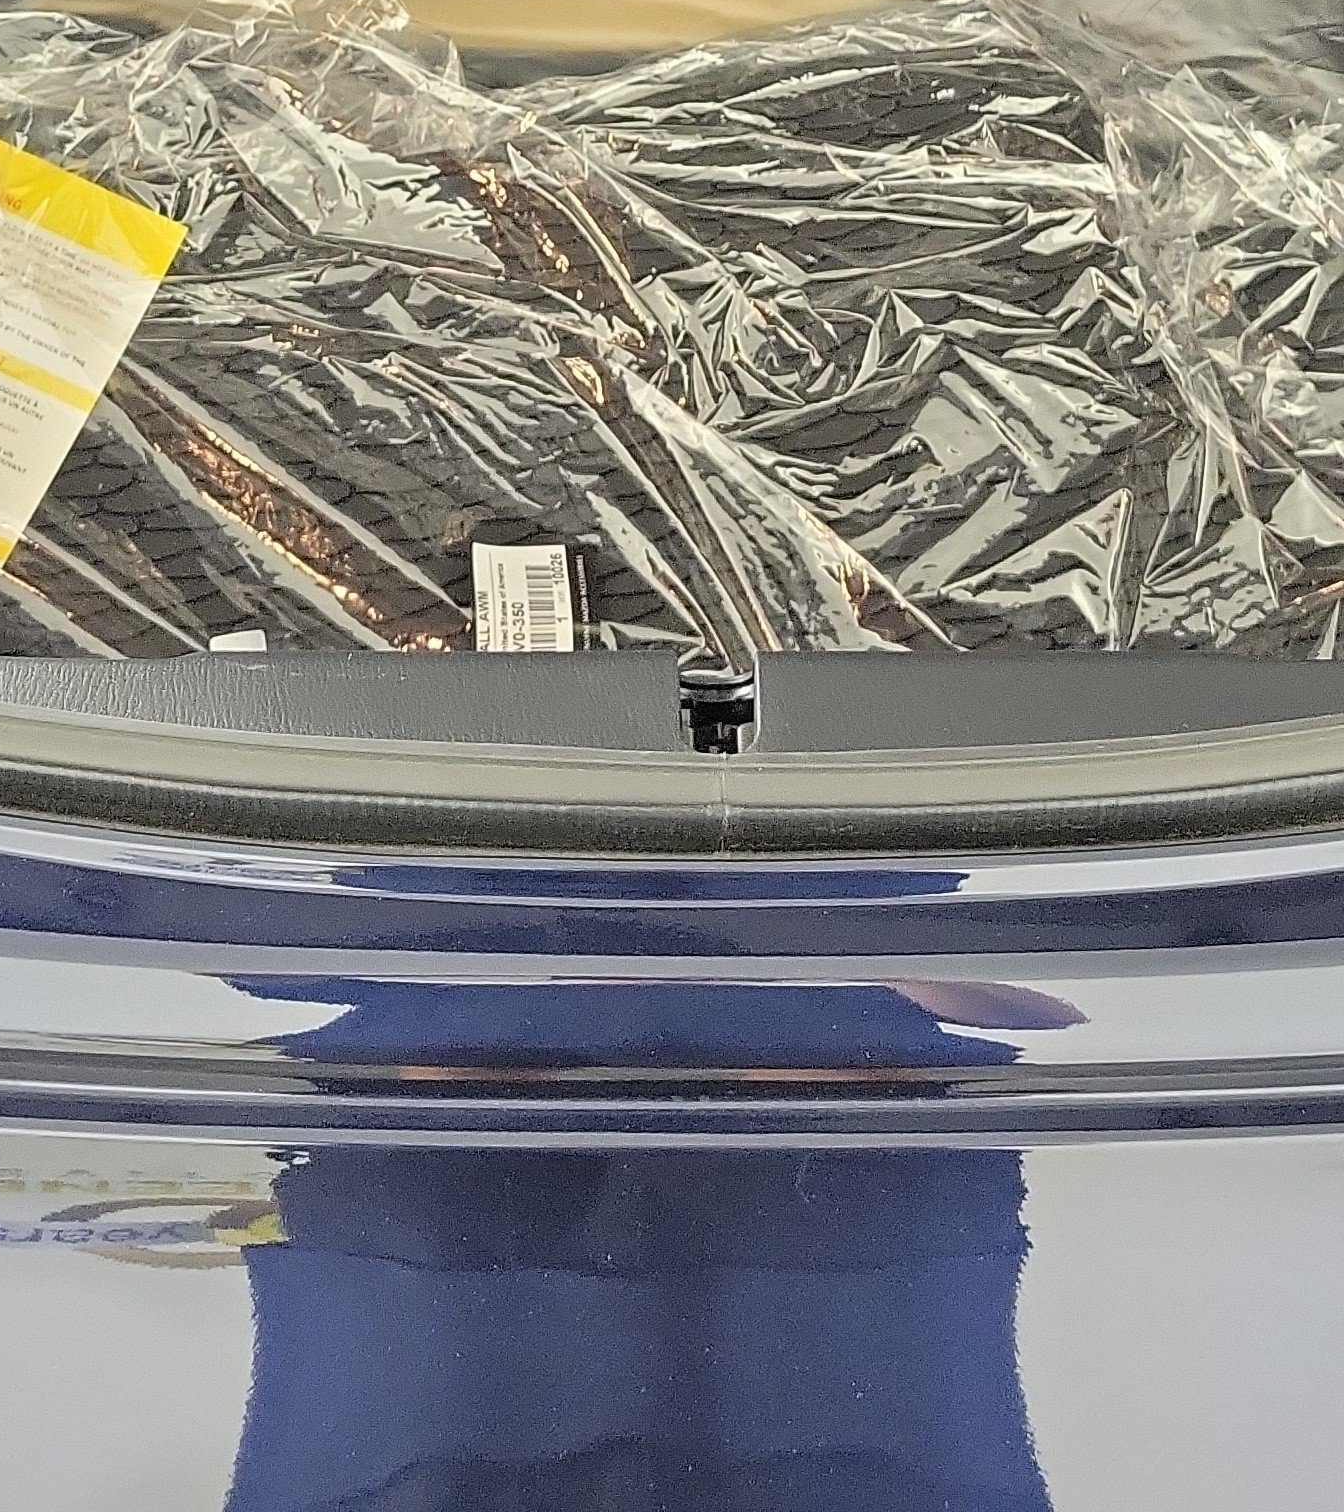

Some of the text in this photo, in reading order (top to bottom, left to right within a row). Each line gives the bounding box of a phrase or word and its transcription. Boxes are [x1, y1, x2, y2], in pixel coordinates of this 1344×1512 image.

[497, 563, 506, 590] America
[550, 553, 565, 585] 10026
[499, 600, 508, 626] States
